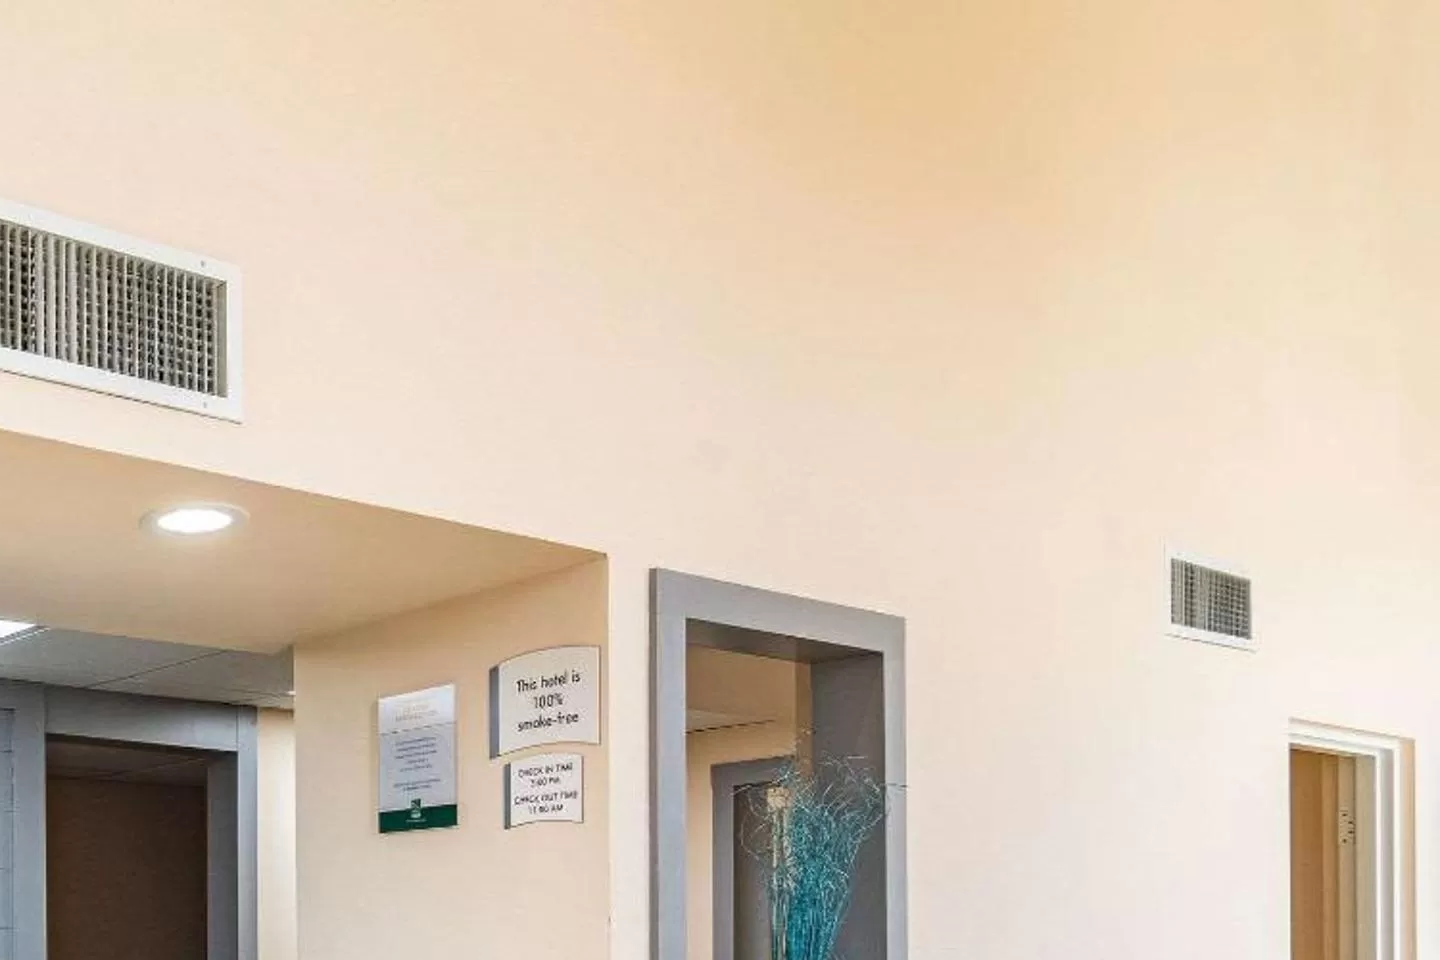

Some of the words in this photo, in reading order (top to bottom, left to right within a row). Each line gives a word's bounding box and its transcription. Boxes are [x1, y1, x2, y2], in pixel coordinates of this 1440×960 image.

[516, 679, 536, 693] This
[540, 670, 569, 688] hotel
[571, 669, 581, 683] is
[533, 692, 564, 709] 100%
[517, 712, 580, 732] smoke-free
